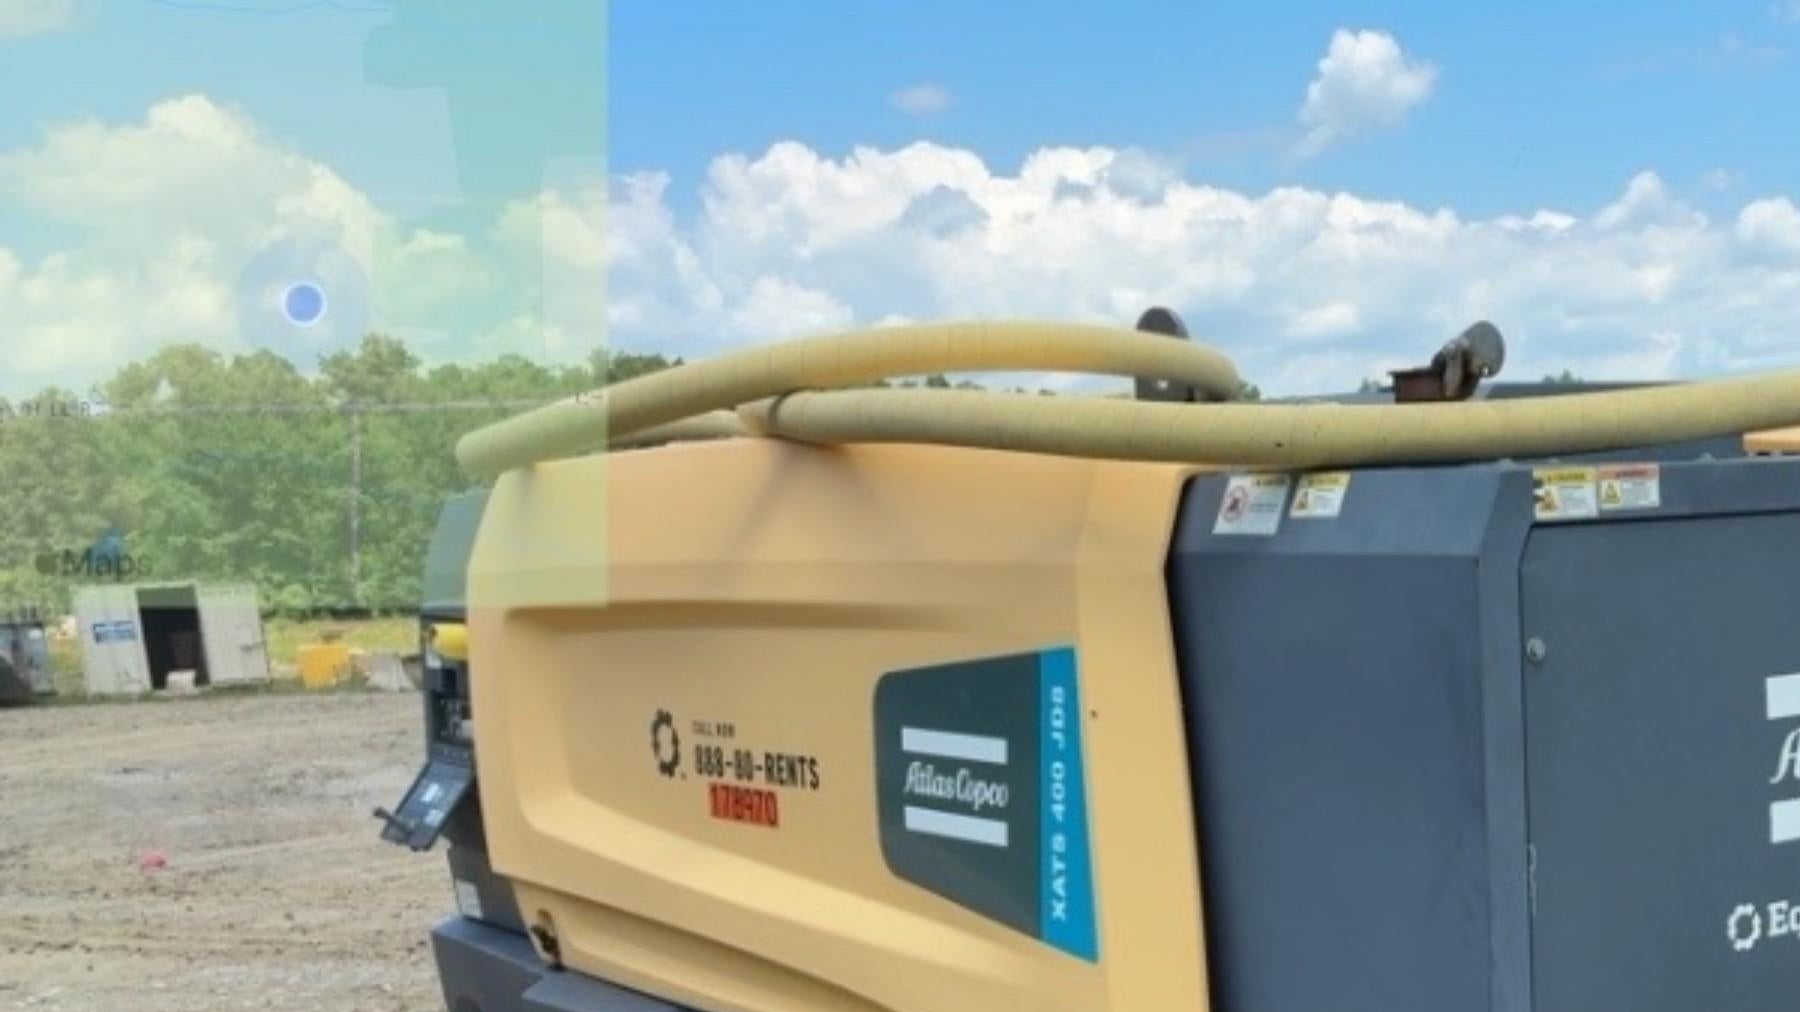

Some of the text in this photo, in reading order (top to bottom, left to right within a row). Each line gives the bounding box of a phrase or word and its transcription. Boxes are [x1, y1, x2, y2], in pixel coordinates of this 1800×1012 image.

[904, 761, 1009, 811] Atlas Copco
[1052, 761, 1066, 823] 400
[1052, 833, 1067, 922] XATS
